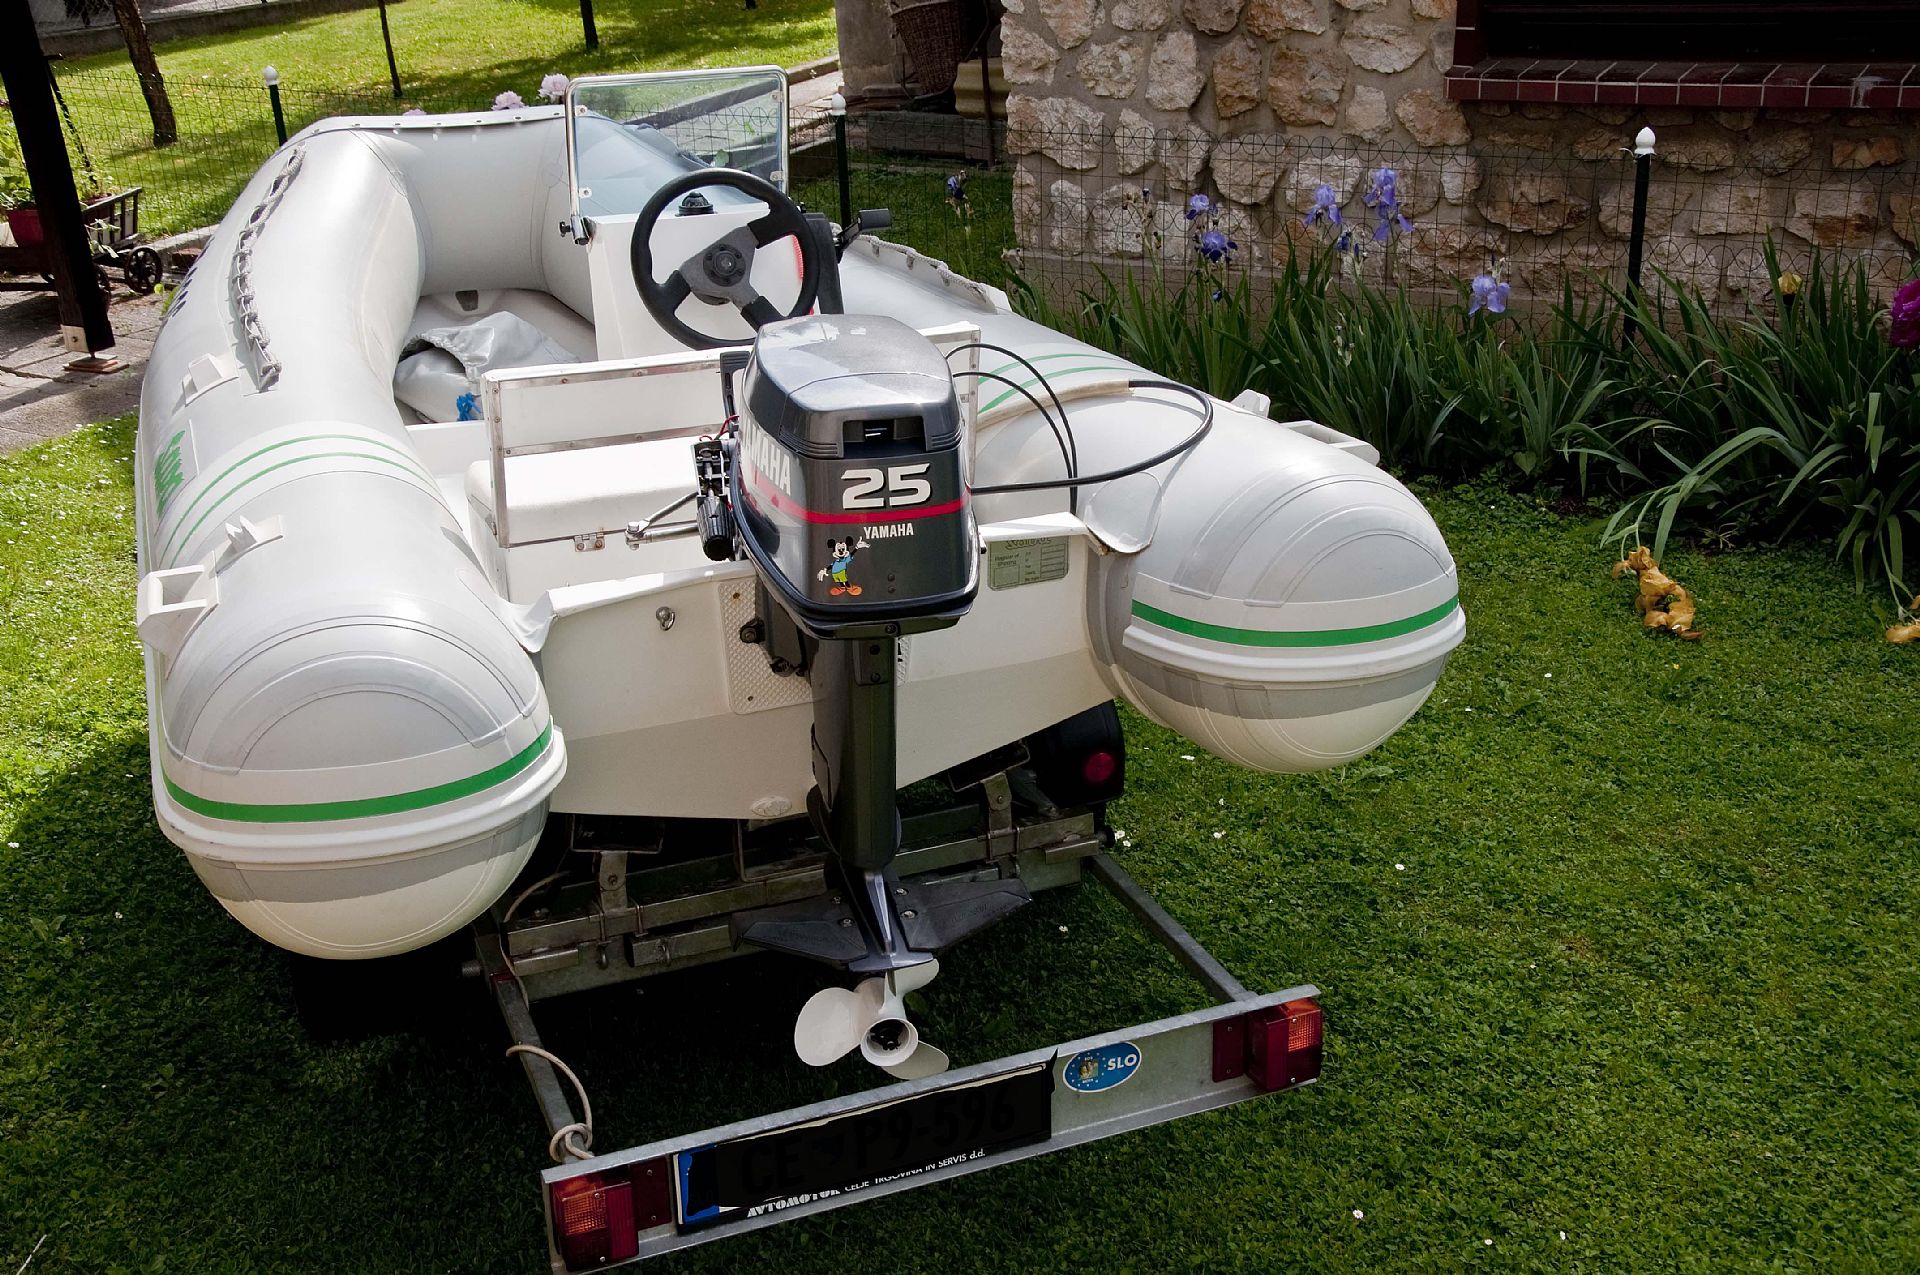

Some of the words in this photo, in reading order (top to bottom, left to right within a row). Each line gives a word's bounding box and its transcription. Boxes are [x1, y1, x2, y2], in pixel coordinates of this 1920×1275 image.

[841, 463, 932, 509] 25
[863, 522, 914, 540] YAMAHA
[1107, 1053, 1138, 1071] SLO
[747, 1189, 841, 1218] AVTOMOTOR
[925, 1163, 936, 1172] IN
[938, 1153, 967, 1168] SERVIS
[969, 1148, 986, 1160] d.d.
